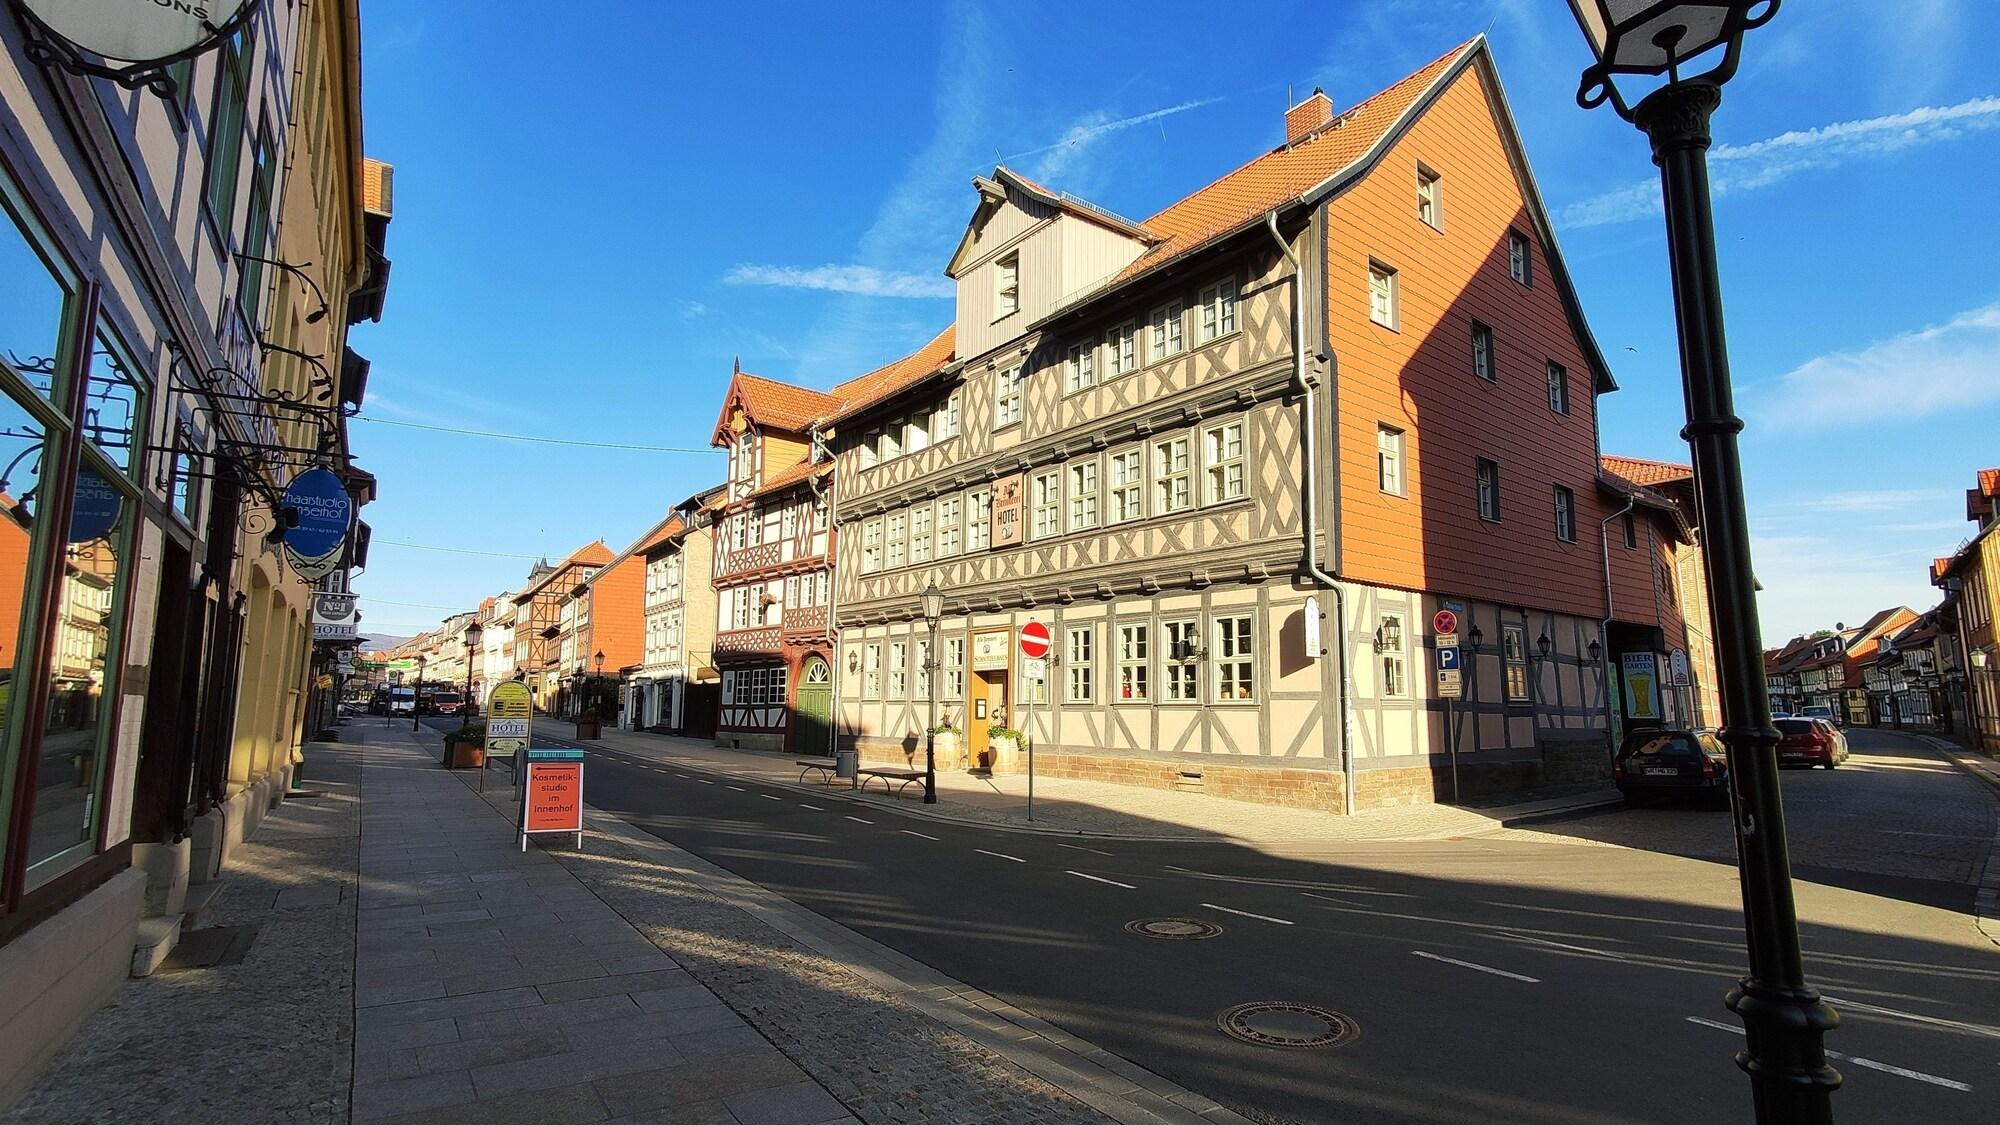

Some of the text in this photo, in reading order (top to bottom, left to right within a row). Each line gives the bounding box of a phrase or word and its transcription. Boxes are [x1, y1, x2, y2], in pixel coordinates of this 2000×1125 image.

[145, 0, 208, 19] ONS
[286, 492, 348, 509] haarstudio
[292, 505, 342, 519] nserhof
[998, 508, 1019, 526] HOTEL
[313, 625, 354, 634] HOTEL
[1441, 650, 1453, 667] P
[532, 774, 576, 782] Kosmetik-
[541, 784, 568, 792] studio
[548, 794, 560, 802] im
[534, 804, 573, 813] Innenhof
